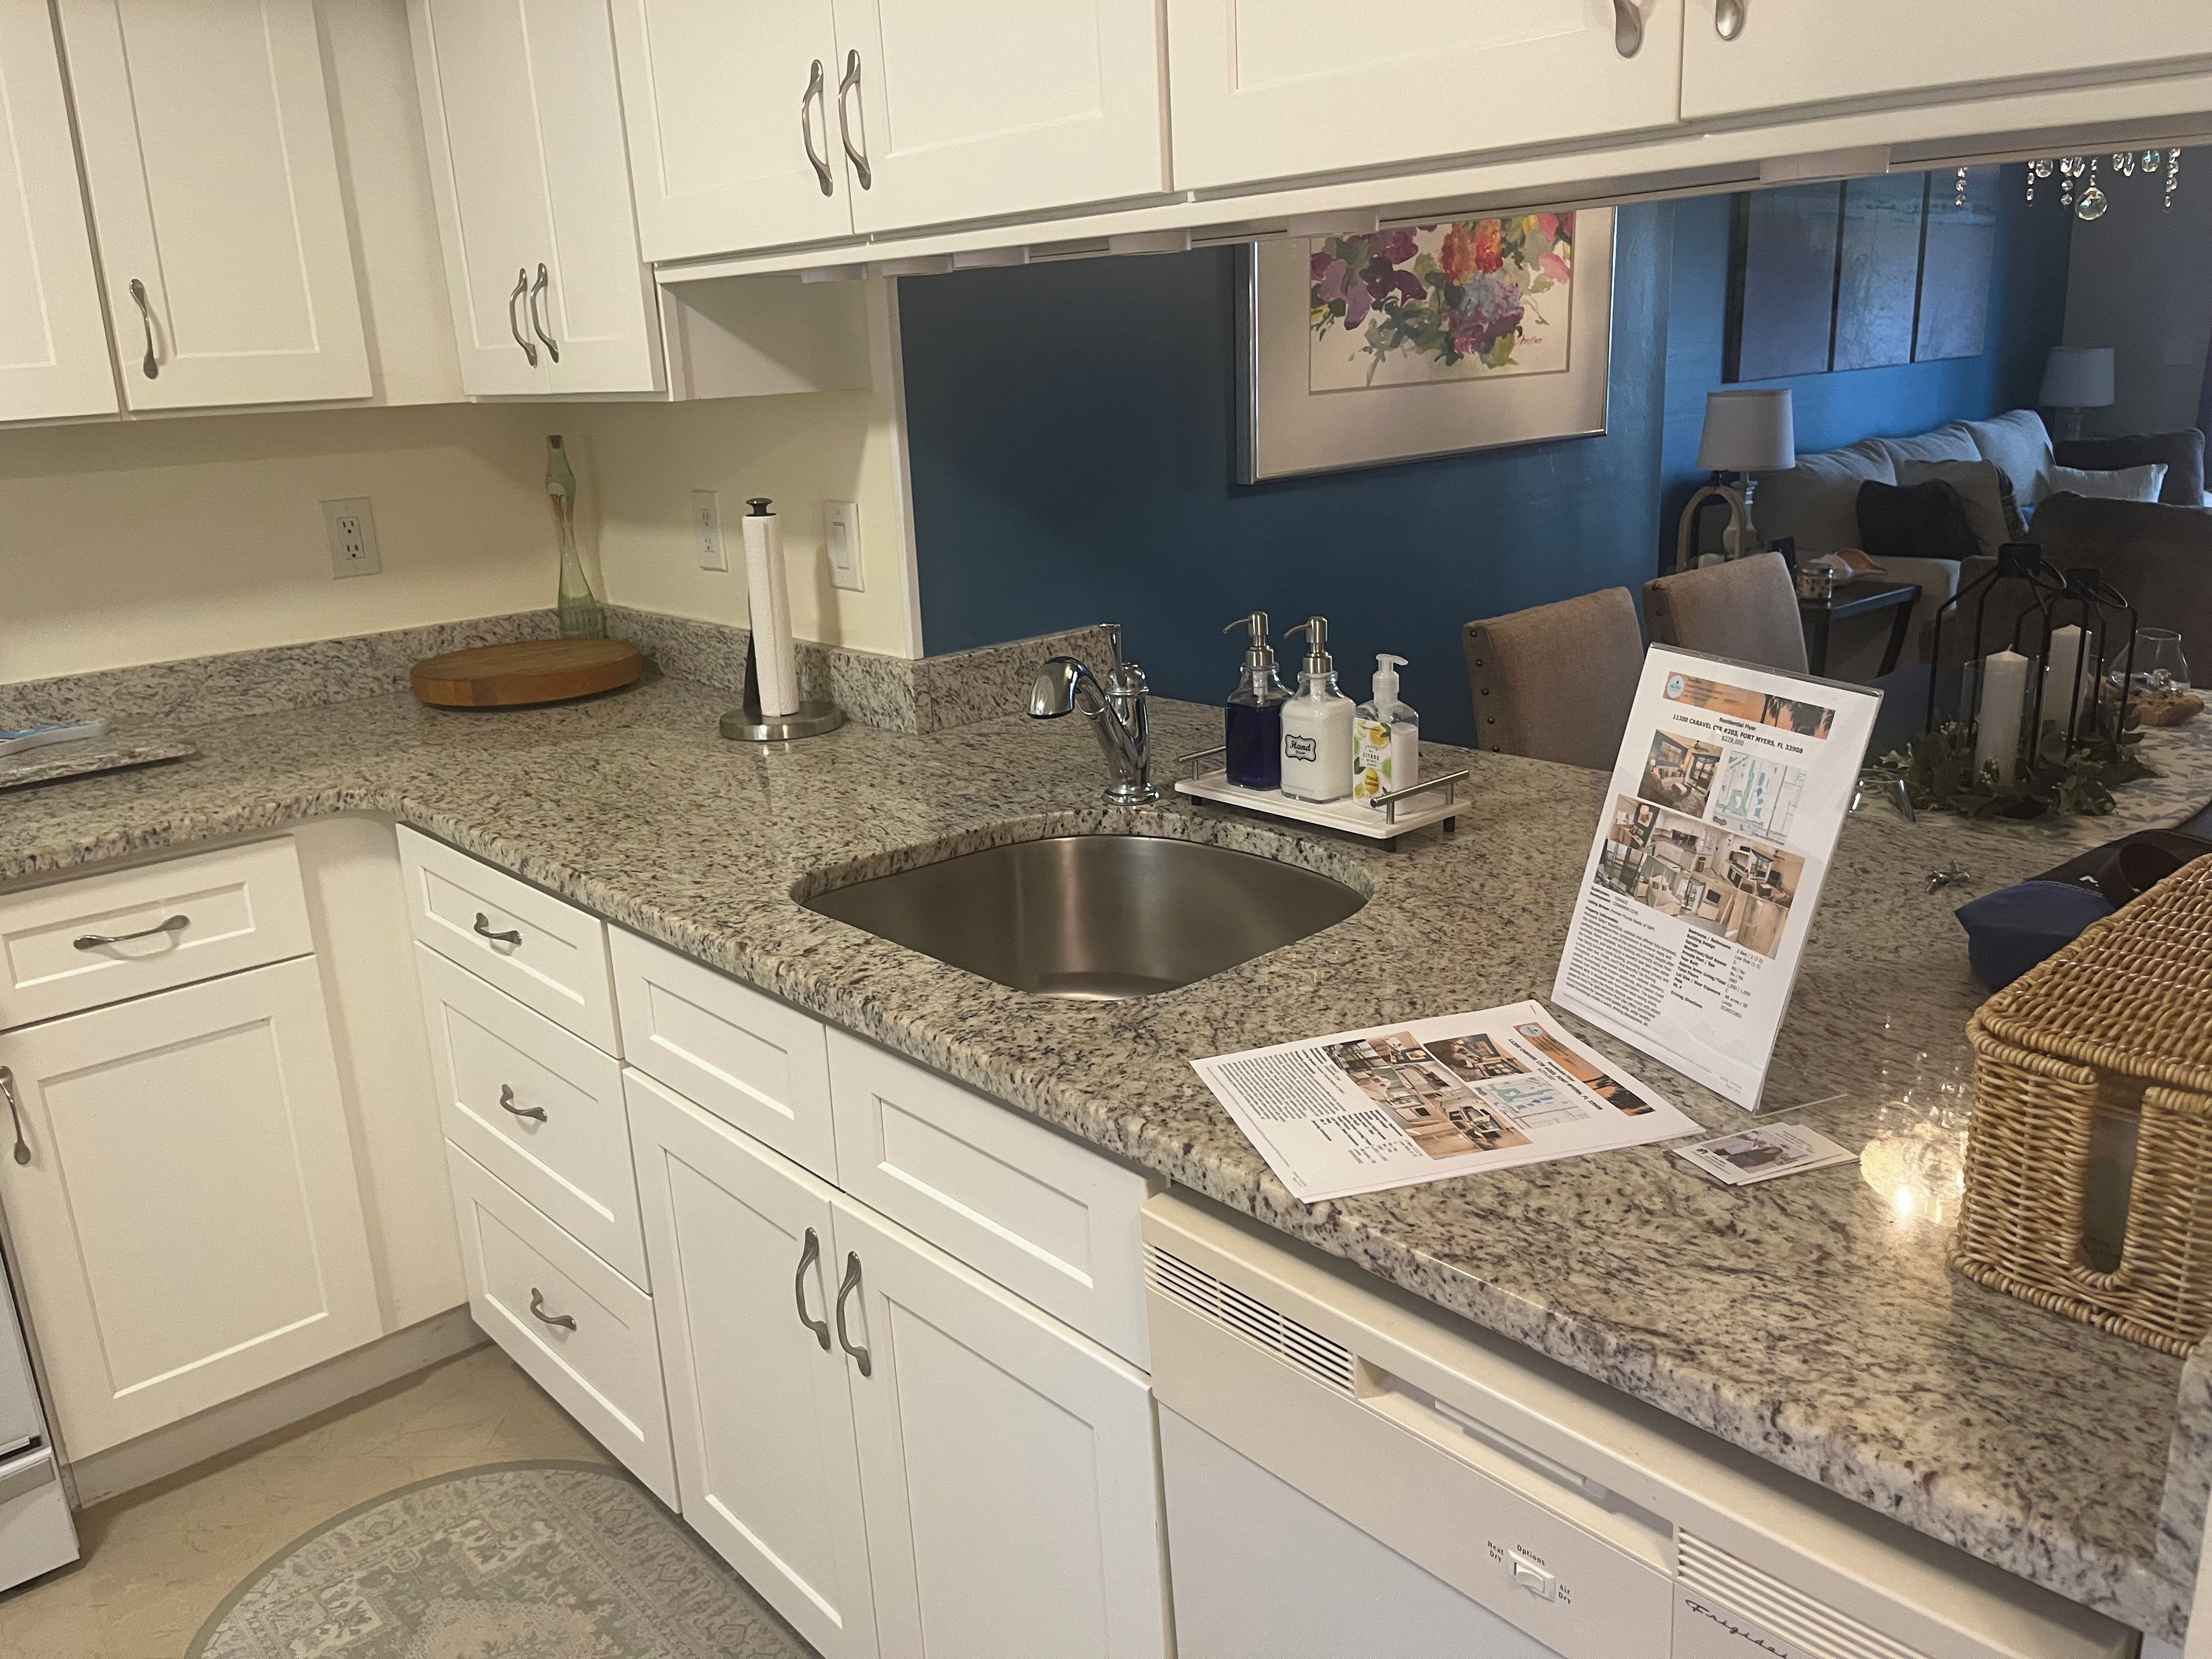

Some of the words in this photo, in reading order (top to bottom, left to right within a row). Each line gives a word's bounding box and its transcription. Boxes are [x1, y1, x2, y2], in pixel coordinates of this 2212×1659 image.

[1689, 718, 1711, 729] CARAVEL
[1740, 732, 1755, 740] FORT
[1755, 736, 1775, 747] MYERS,
[1785, 744, 1804, 753] 33908
[1290, 740, 1310, 751] Hand
[1487, 1540, 1503, 1555] Heat
[1490, 1550, 1502, 1563] Dry
[1517, 1544, 1545, 1566] Options
[1559, 1584, 1570, 1594] Air
[1558, 1592, 1571, 1604] Dry
